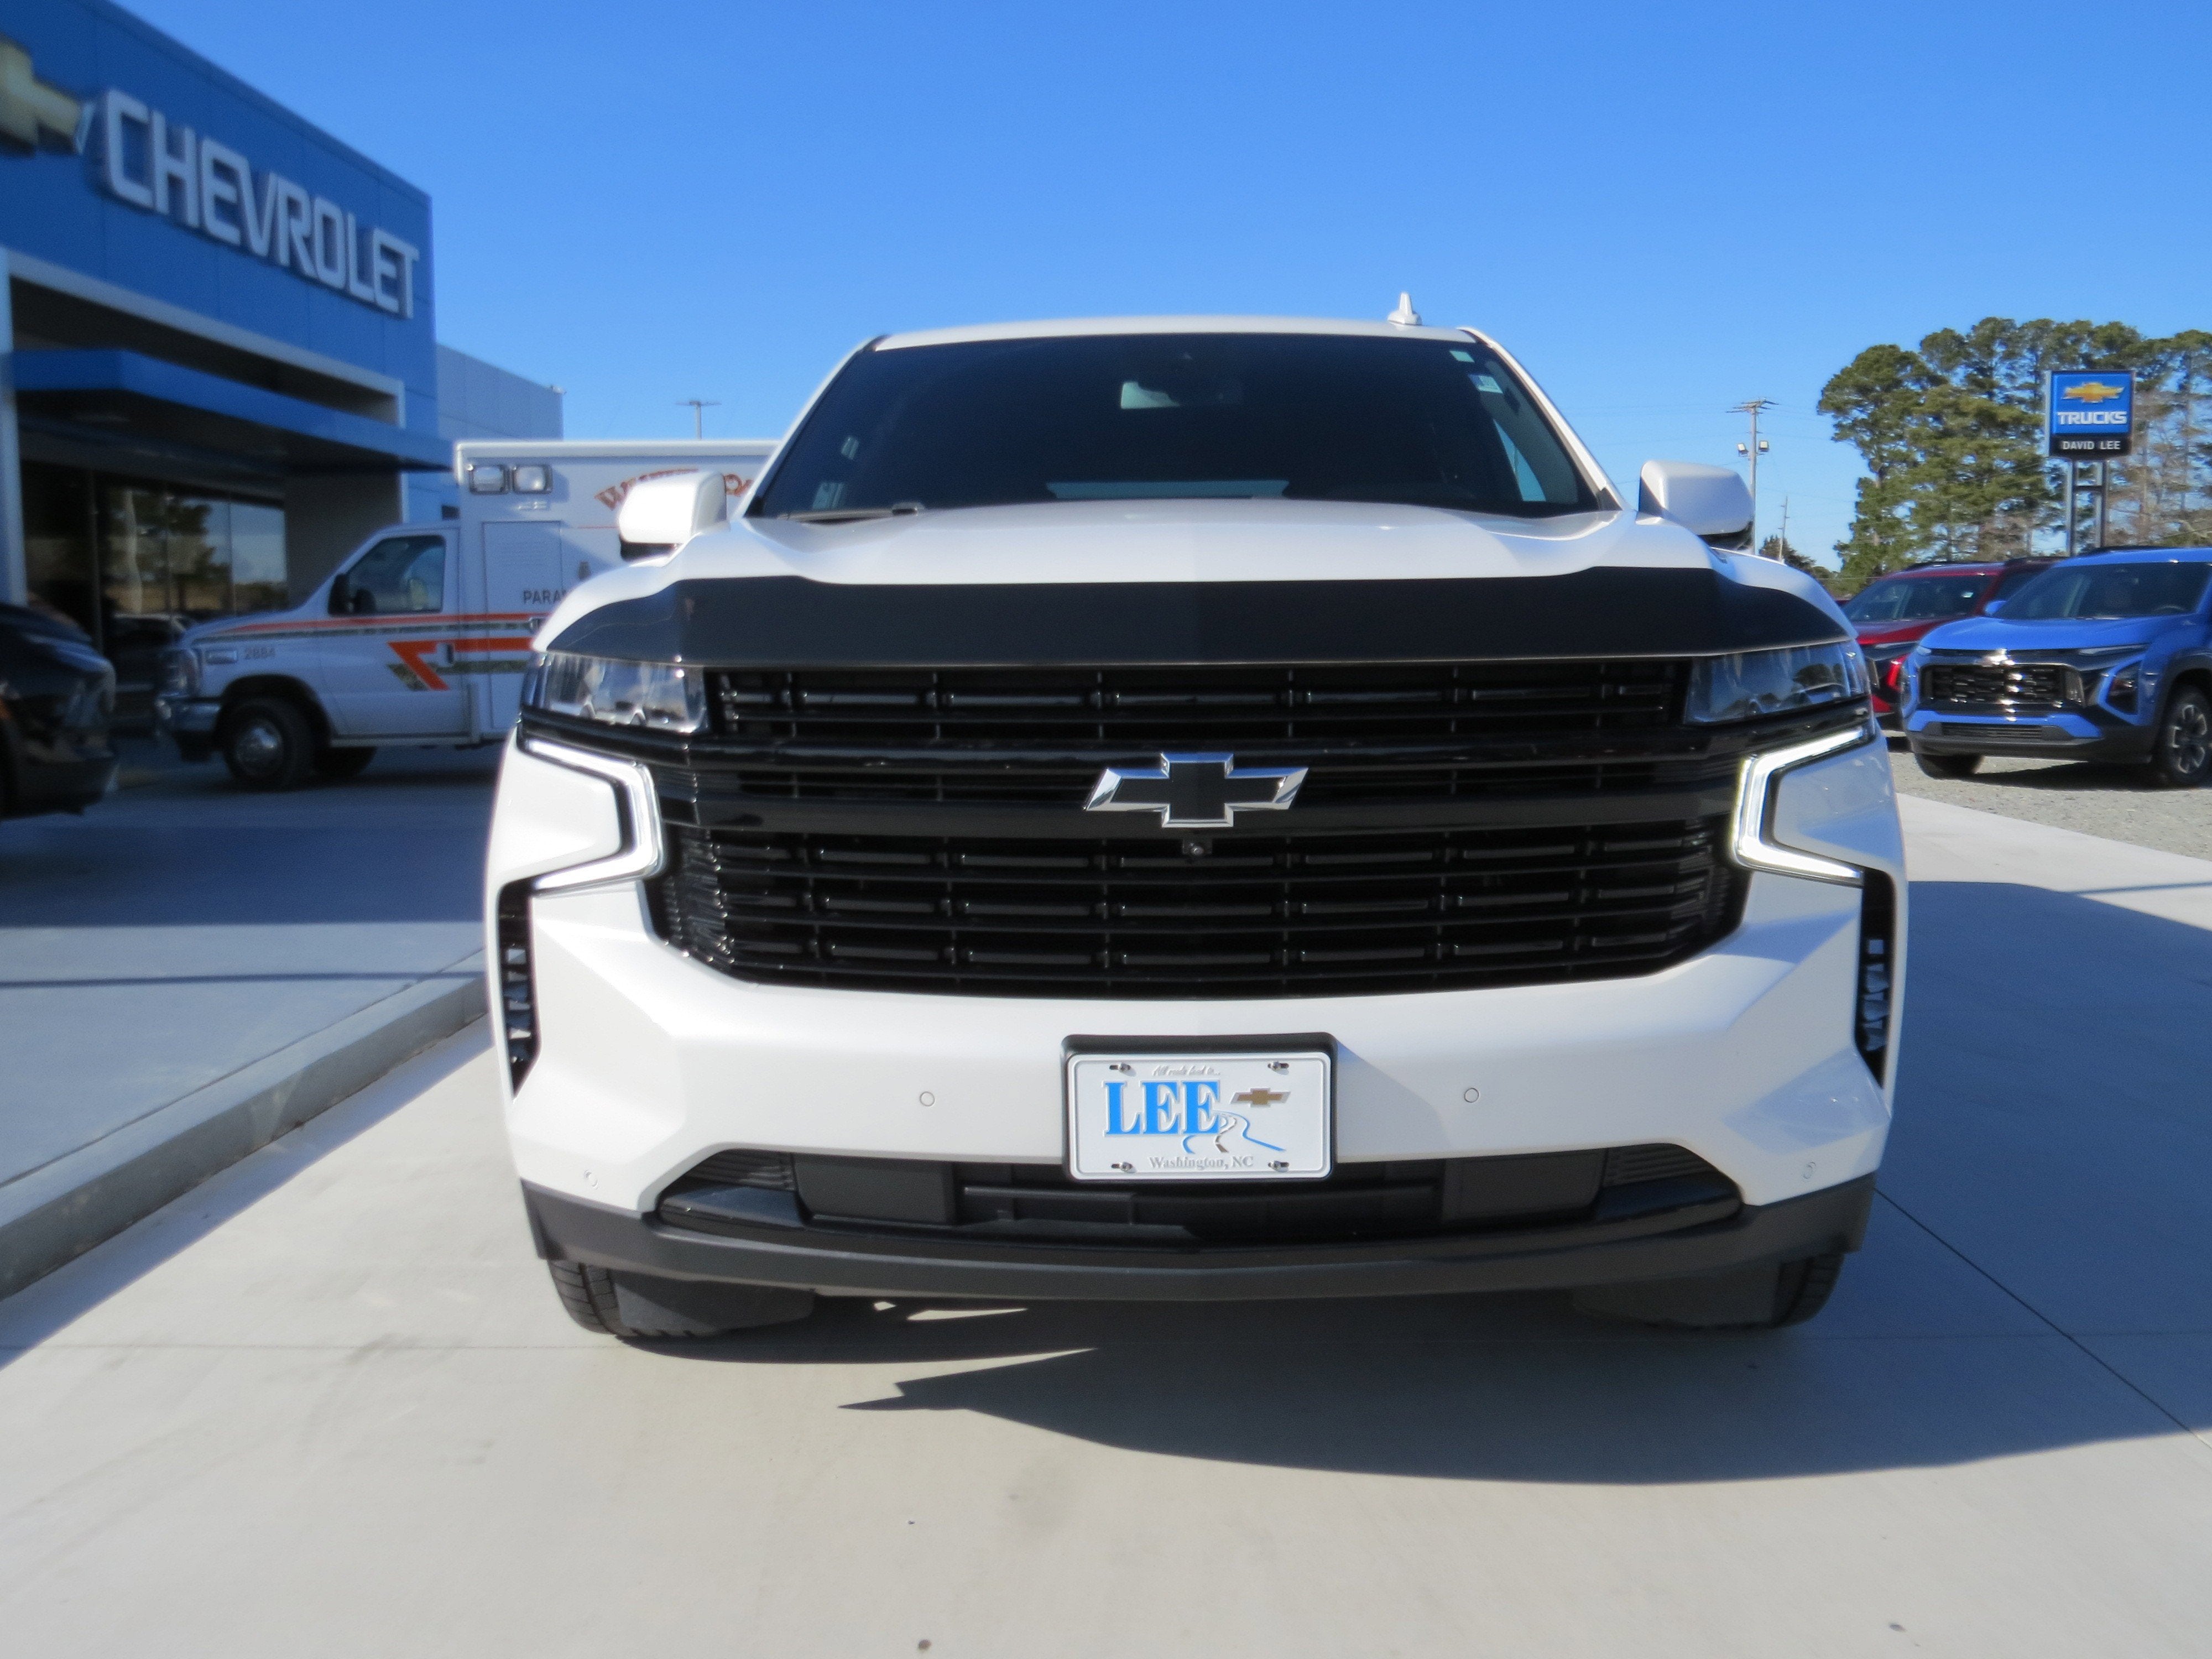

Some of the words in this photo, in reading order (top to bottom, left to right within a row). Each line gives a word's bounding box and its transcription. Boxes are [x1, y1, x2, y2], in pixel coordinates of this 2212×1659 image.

[107, 88, 419, 319] CHEVROLET
[2057, 411, 2127, 425] TRUCKS
[2062, 441, 2095, 450] DAVID
[2100, 441, 2121, 450] LEE
[1102, 1080, 1220, 1135] LEE
[1149, 1155, 1229, 1170] Washington,
[1231, 1156, 1254, 1168] NC
